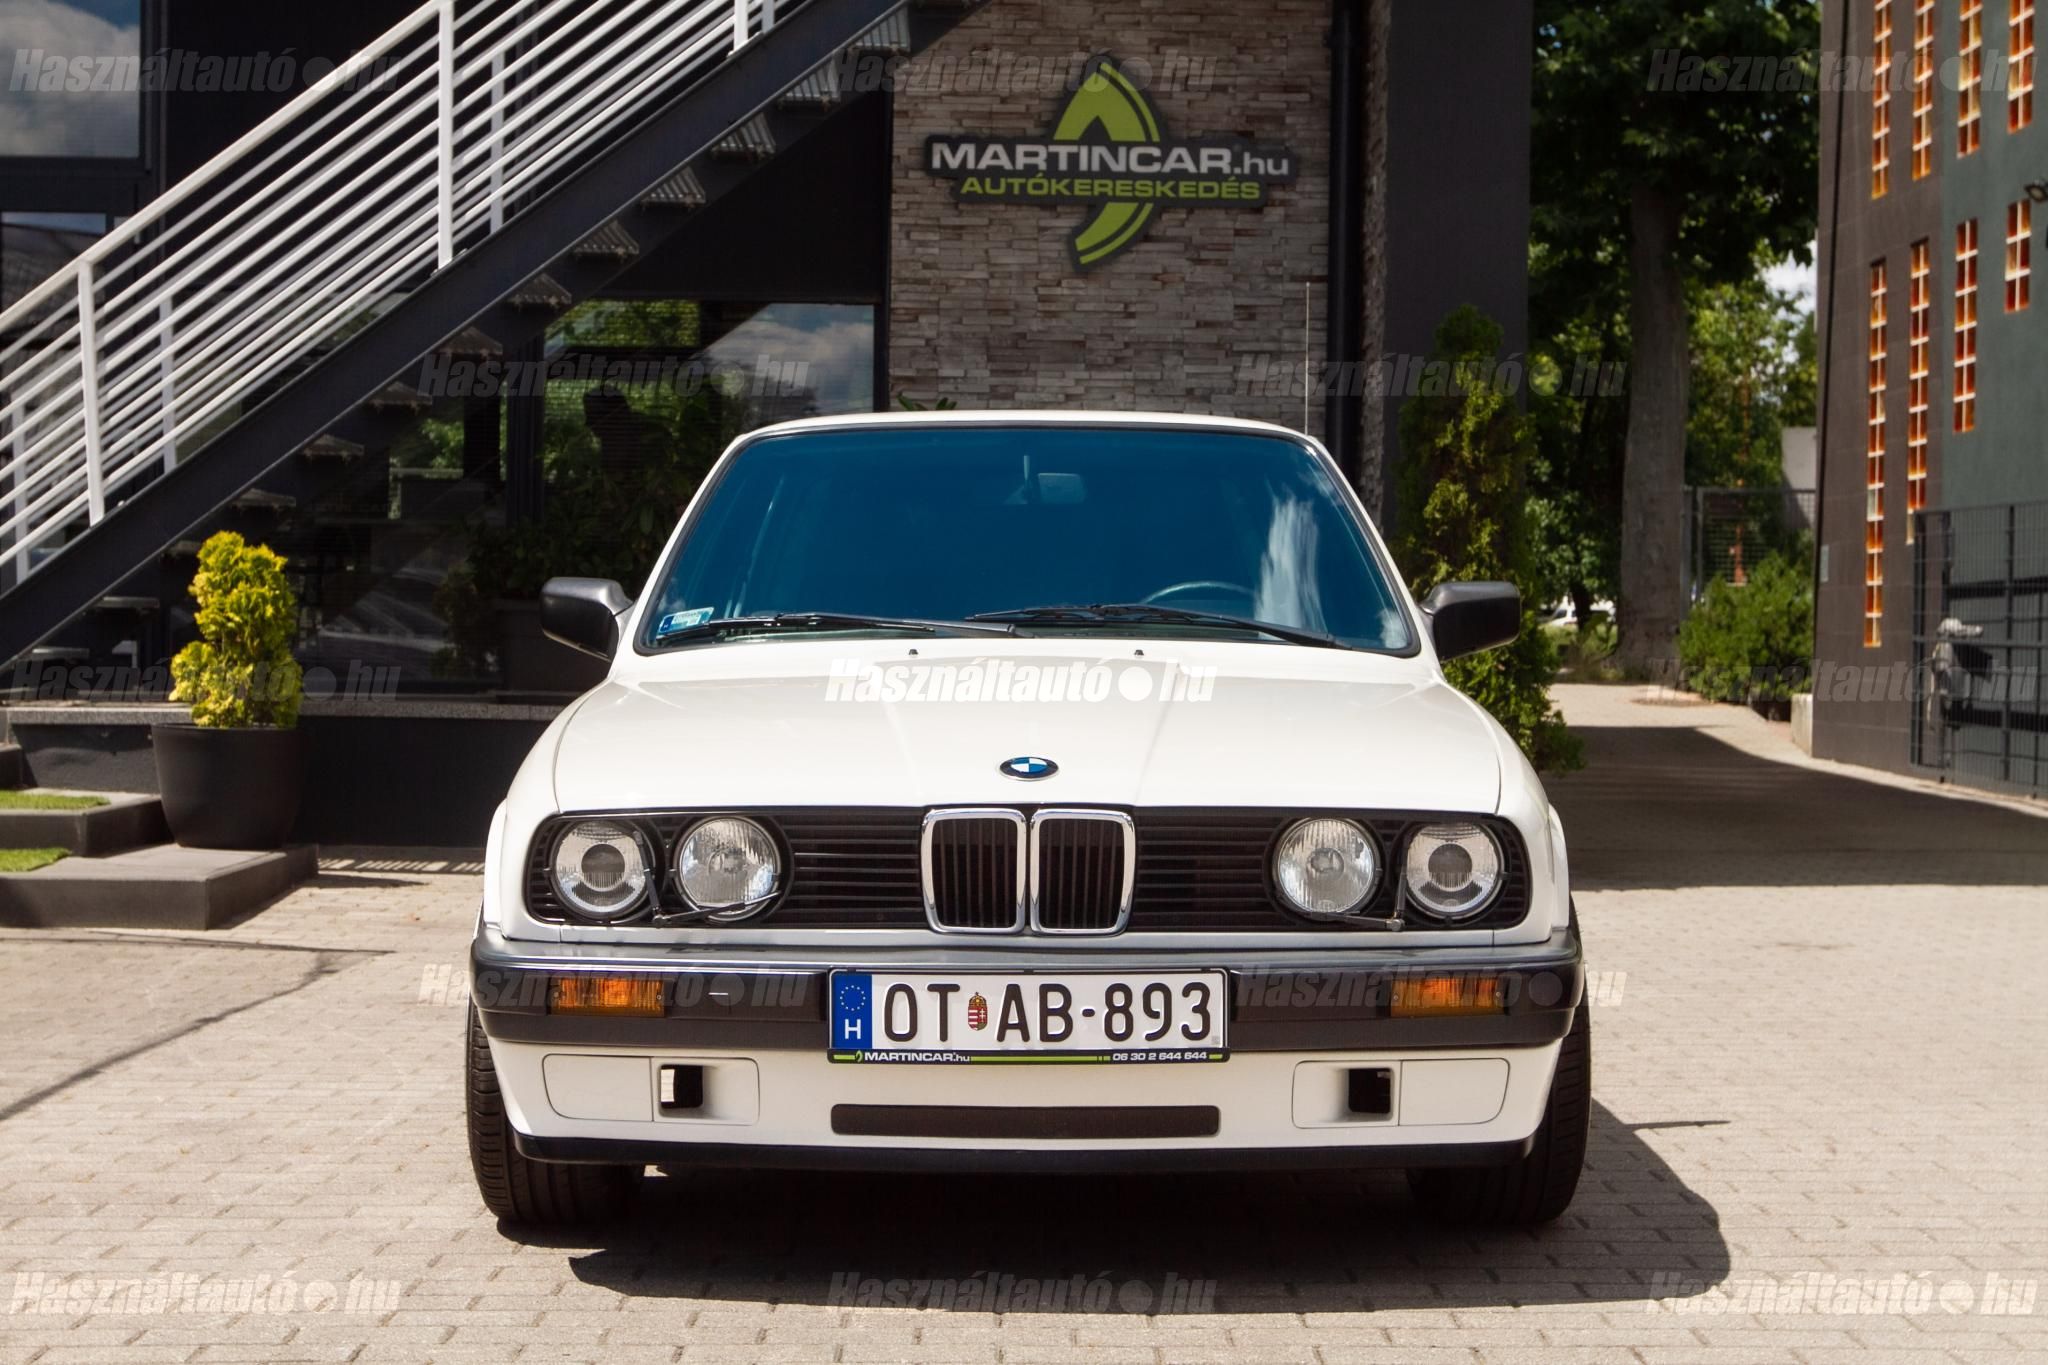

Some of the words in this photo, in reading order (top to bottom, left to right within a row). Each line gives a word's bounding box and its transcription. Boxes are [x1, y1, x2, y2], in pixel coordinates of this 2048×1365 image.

[931, 142, 1289, 175] MARTINCAR.hu
[960, 172, 1261, 199] AUTÓKERESKEDÉS
[844, 1019, 861, 1039] H
[864, 1051, 970, 1063] MARTINCAR.hu
[1112, 1053, 1128, 1061] 06
[1130, 1053, 1145, 1061] 30
[1148, 1053, 1156, 1061] 2
[1158, 1053, 1182, 1061] 644
[1184, 1052, 1207, 1060] 644
